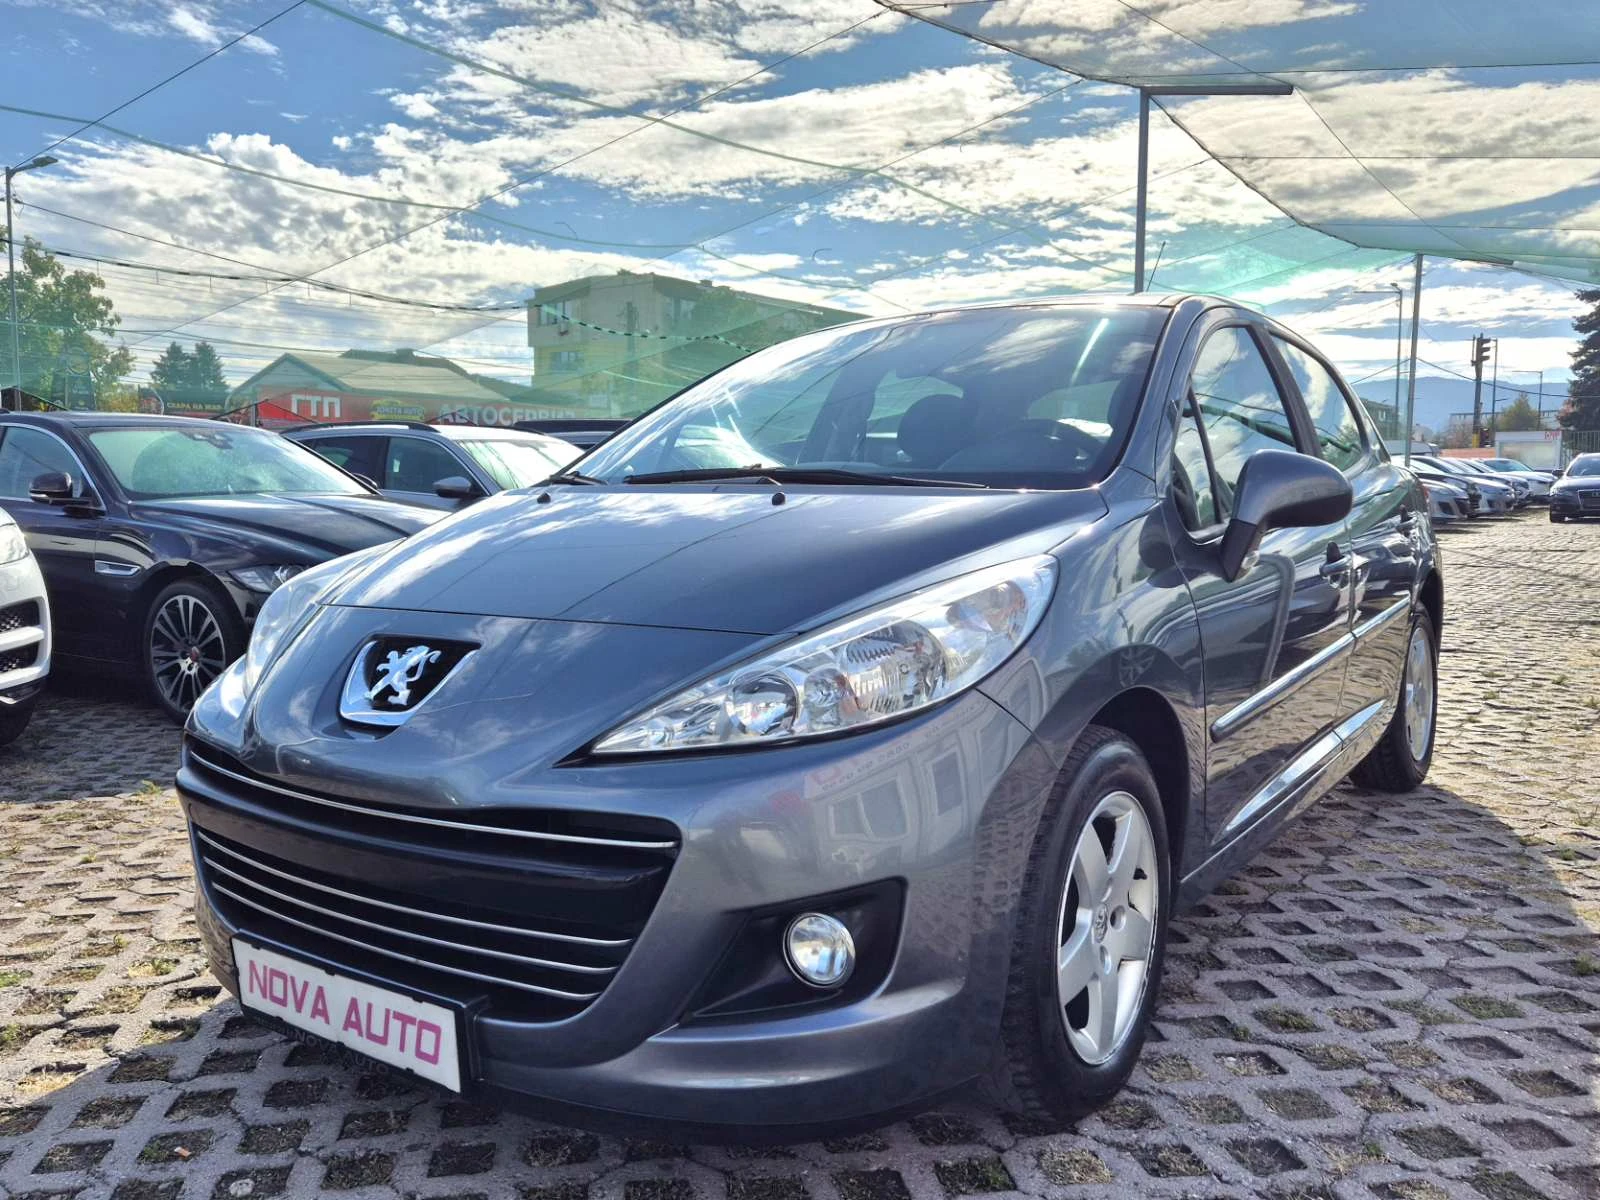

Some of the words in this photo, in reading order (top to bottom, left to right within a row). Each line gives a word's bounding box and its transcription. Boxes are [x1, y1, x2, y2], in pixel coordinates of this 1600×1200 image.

[291, 394, 341, 417] ГТП
[249, 960, 331, 1025] NOVA
[343, 998, 441, 1065] AUTO
